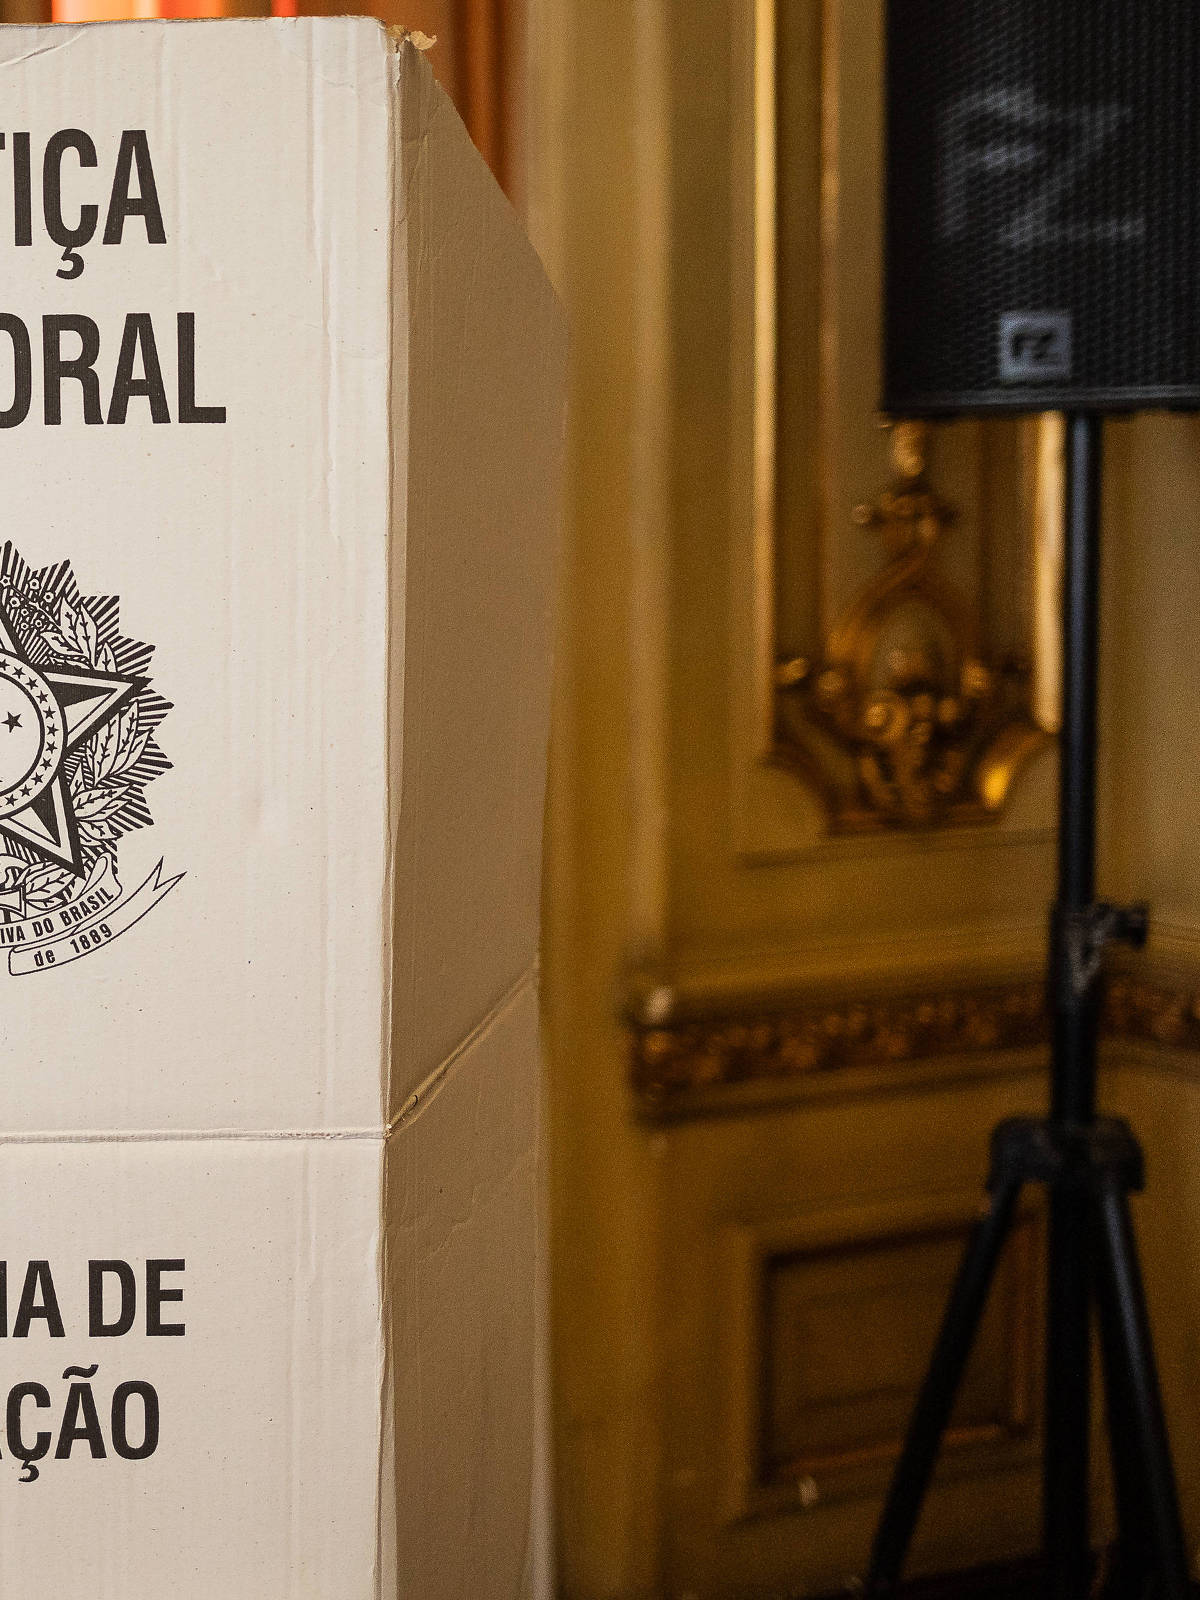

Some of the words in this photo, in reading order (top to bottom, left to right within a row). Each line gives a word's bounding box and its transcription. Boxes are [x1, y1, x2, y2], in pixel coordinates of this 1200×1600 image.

[31, 917, 55, 938] DO
[58, 886, 114, 927] BRASIL
[33, 949, 56, 967] de
[69, 923, 113, 954] 1889
[87, 1258, 187, 1338] DE
